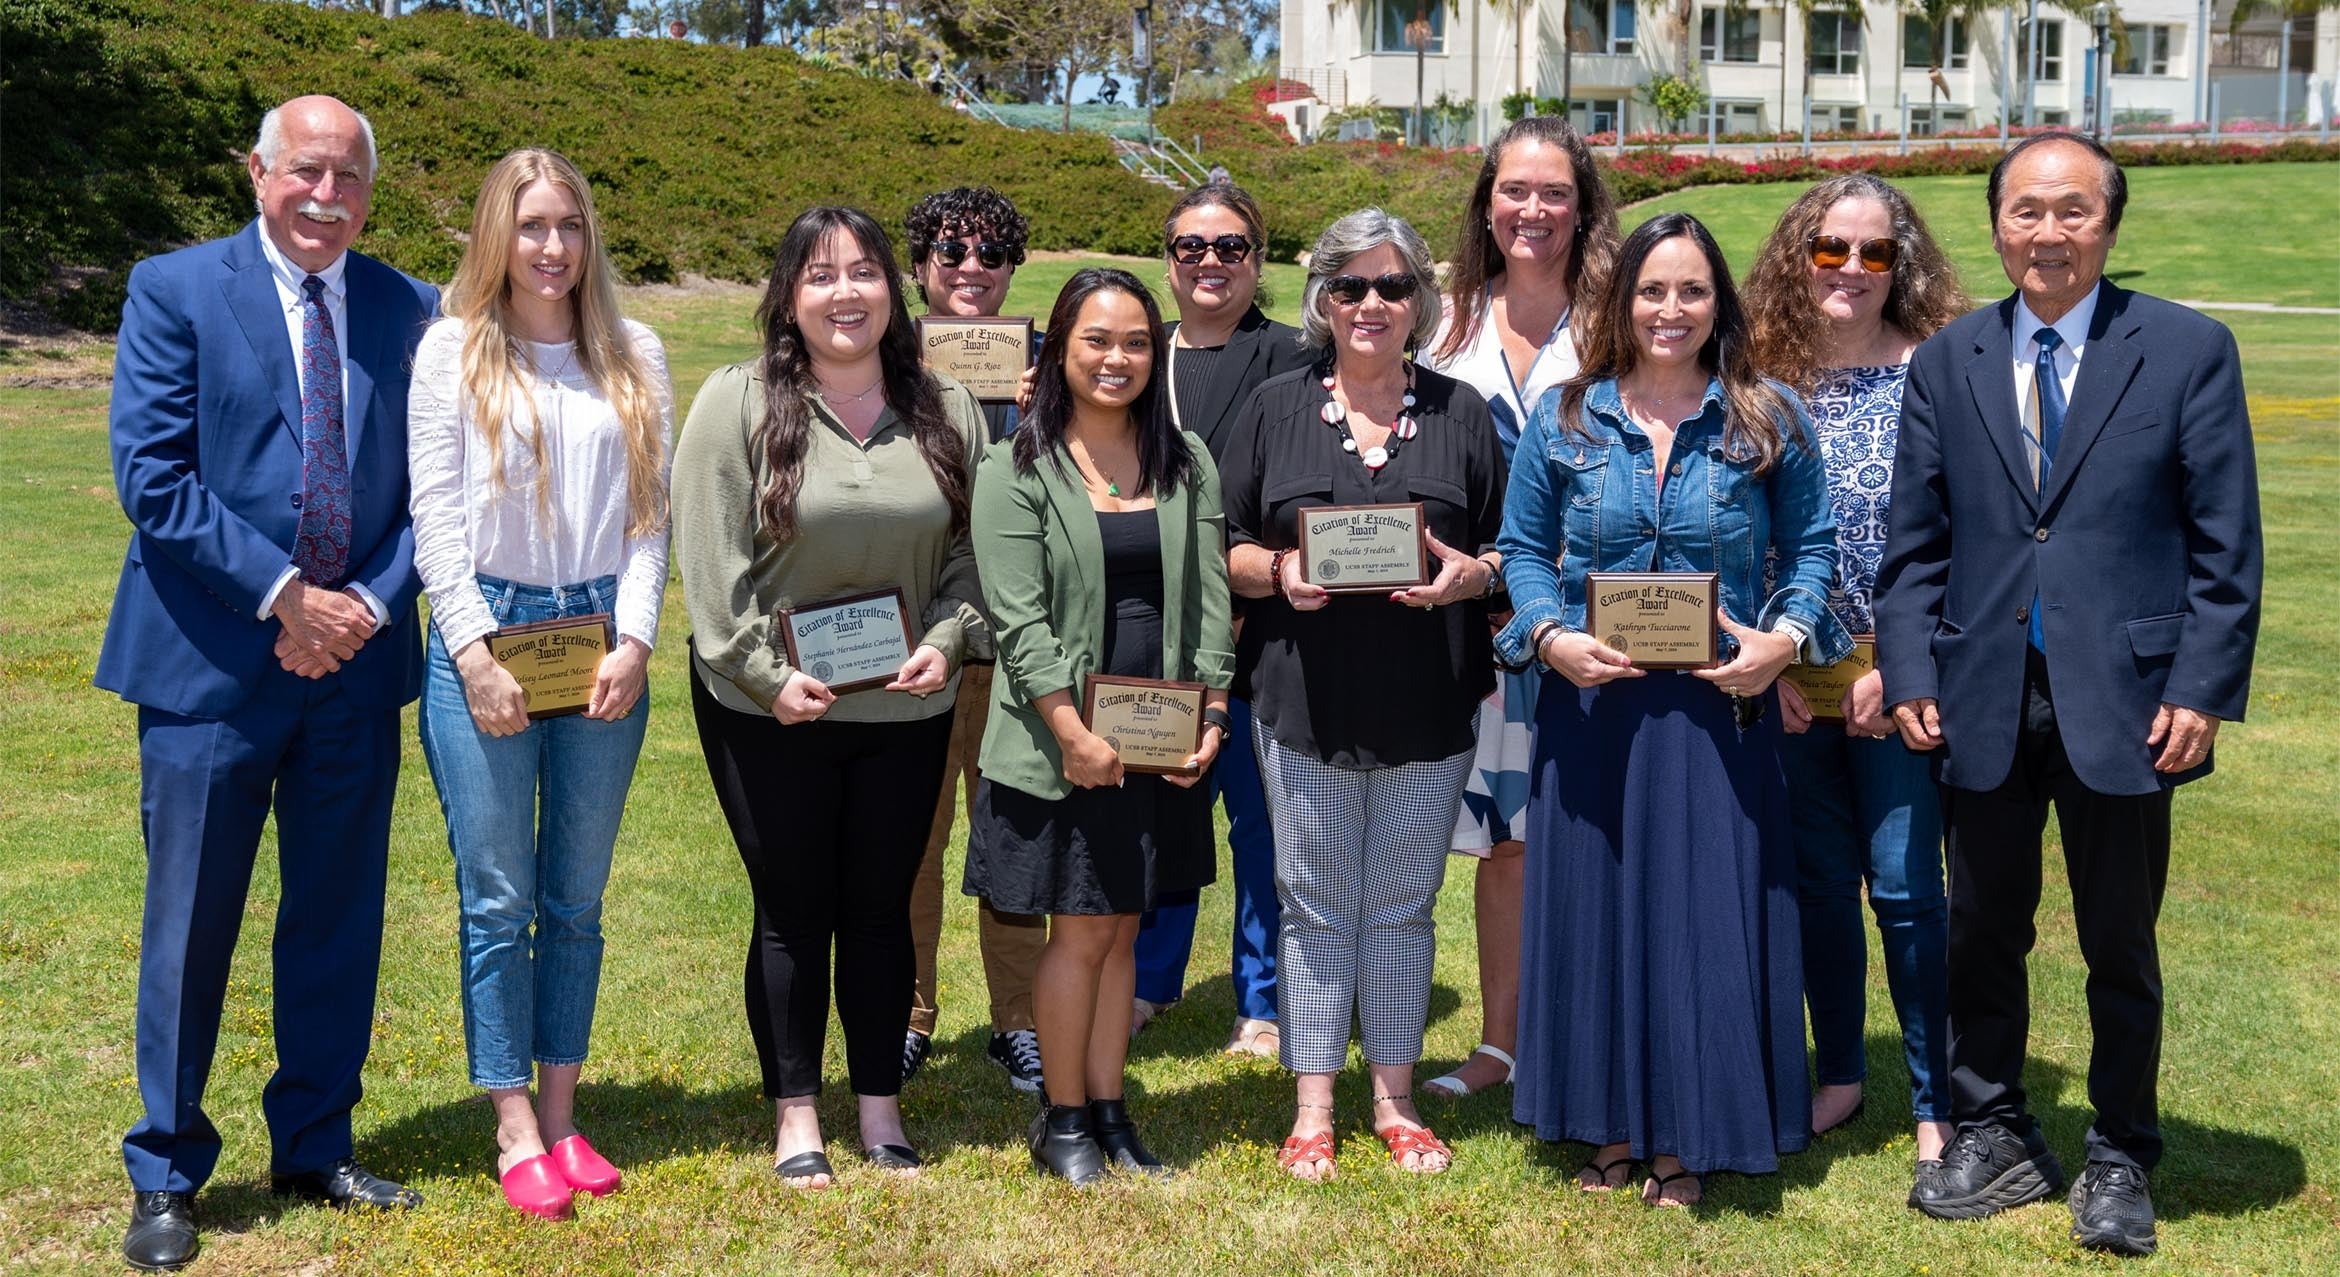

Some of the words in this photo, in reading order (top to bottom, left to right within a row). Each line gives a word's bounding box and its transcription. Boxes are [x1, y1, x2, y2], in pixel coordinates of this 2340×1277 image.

[928, 331, 964, 348] Citation
[966, 328, 975, 340] of
[978, 328, 1022, 349] Excellence
[961, 339, 990, 350] Award
[950, 362, 971, 371] Quinn
[974, 362, 982, 372] G.
[1312, 518, 1348, 535] Citation
[1352, 514, 1362, 524] of
[1364, 514, 1412, 532] Excellence
[1346, 525, 1378, 536] Award
[1328, 547, 1362, 556] Michelle
[1363, 545, 1396, 556] Fredrich
[1600, 590, 1639, 607] Citation
[1642, 586, 1653, 598] of
[1655, 586, 1704, 608] Excellence
[1636, 599, 1669, 610] Award
[797, 614, 834, 638] Citation
[836, 609, 845, 620] of
[848, 607, 895, 621] Excellence
[832, 620, 864, 634] Award
[1613, 623, 1646, 634] Kathryn
[1648, 623, 1690, 632] Tucciarone
[498, 640, 536, 662] Citation
[539, 635, 548, 648] of
[552, 634, 600, 650] Excellence
[534, 646, 567, 660] Award
[802, 648, 835, 661] Stephanie
[874, 635, 902, 647] Carbajal
[854, 659, 871, 668] STAFF
[872, 653, 901, 663] ASSEMBLY
[539, 670, 569, 681] Leonard
[570, 667, 594, 676] Moore
[1099, 692, 1135, 709] Citation
[1138, 691, 1148, 702] of
[1150, 692, 1194, 716] Excellence
[1132, 703, 1162, 716] Award
[1112, 725, 1146, 736] Christina
[1147, 728, 1176, 740] Nguyen
